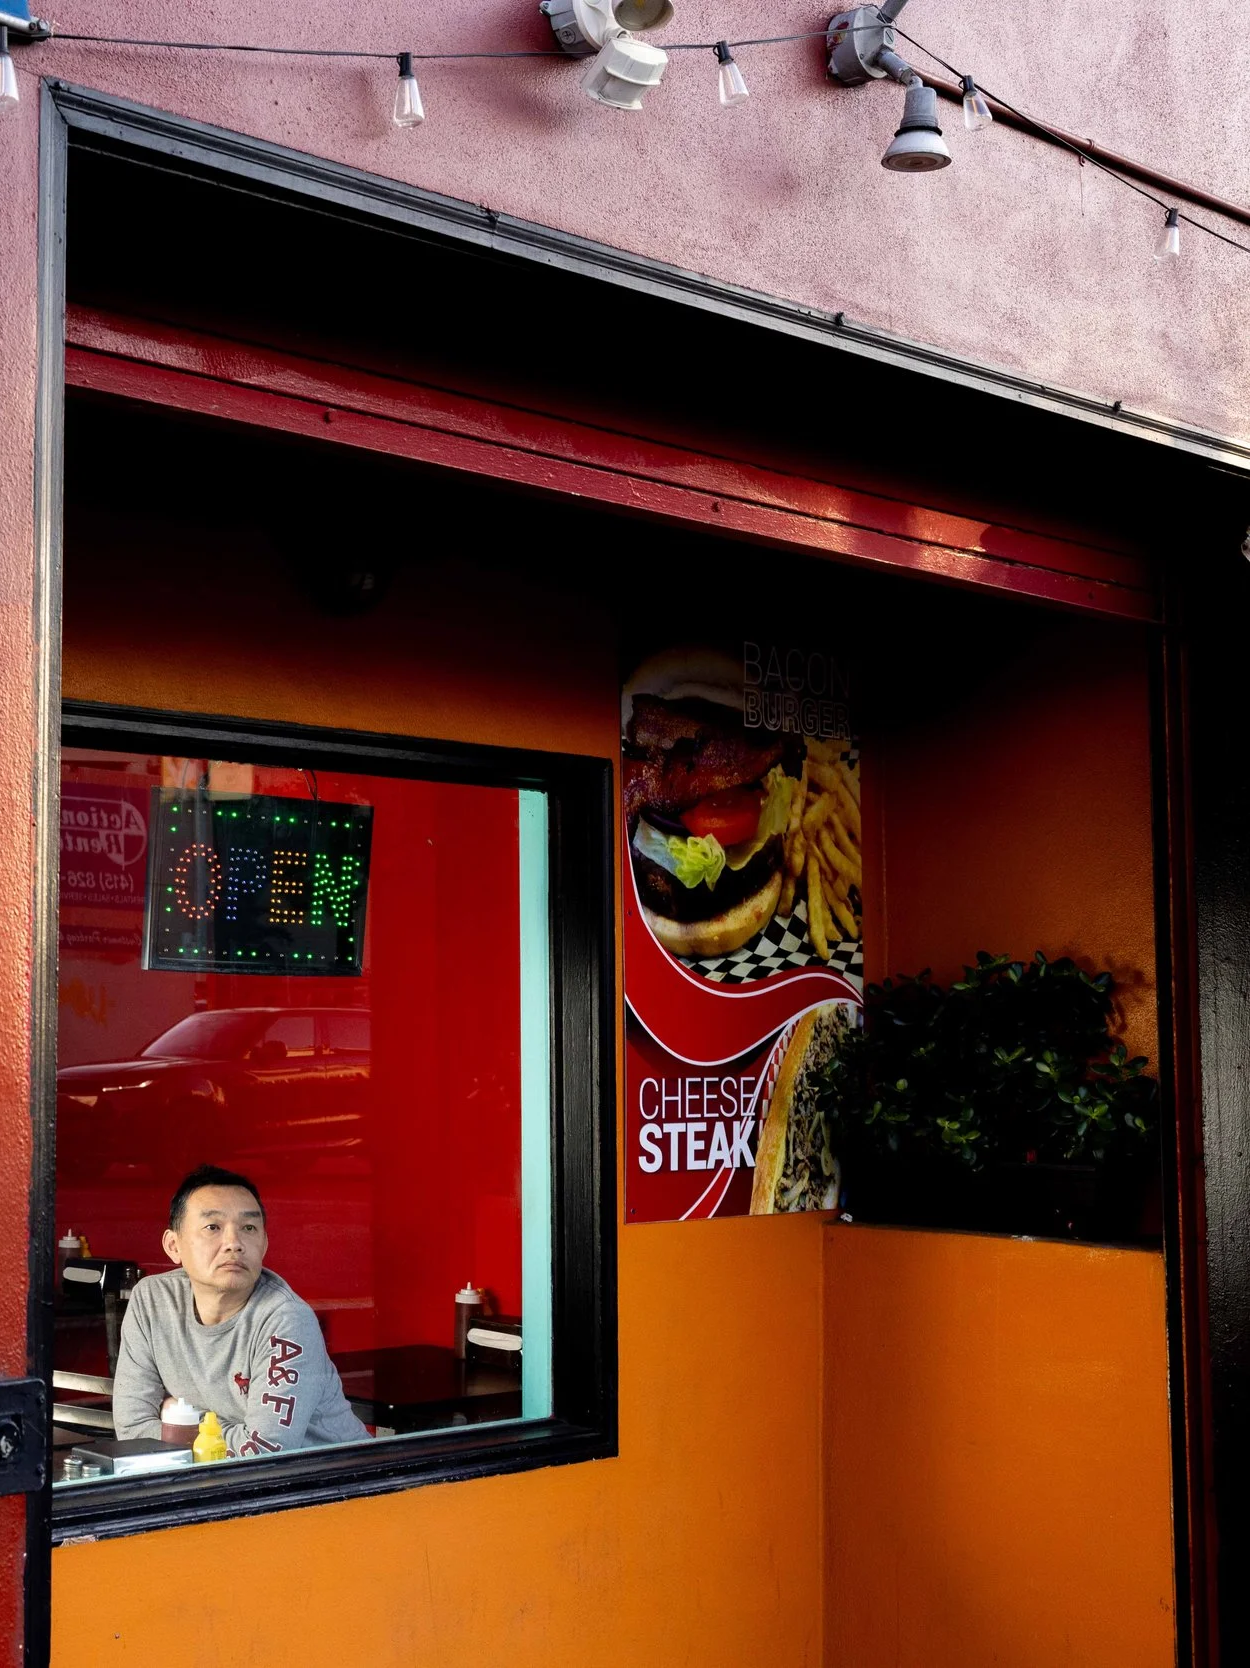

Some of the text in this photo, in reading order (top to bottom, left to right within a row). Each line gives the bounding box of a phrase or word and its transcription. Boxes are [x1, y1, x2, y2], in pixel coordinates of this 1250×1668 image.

[743, 641, 850, 699] BACON
[743, 688, 851, 740] BURGER
[174, 843, 360, 927] OPEN
[639, 1076, 756, 1120] CHEESE
[638, 1120, 756, 1173] STEAK
[261, 1334, 303, 1428] A&F
